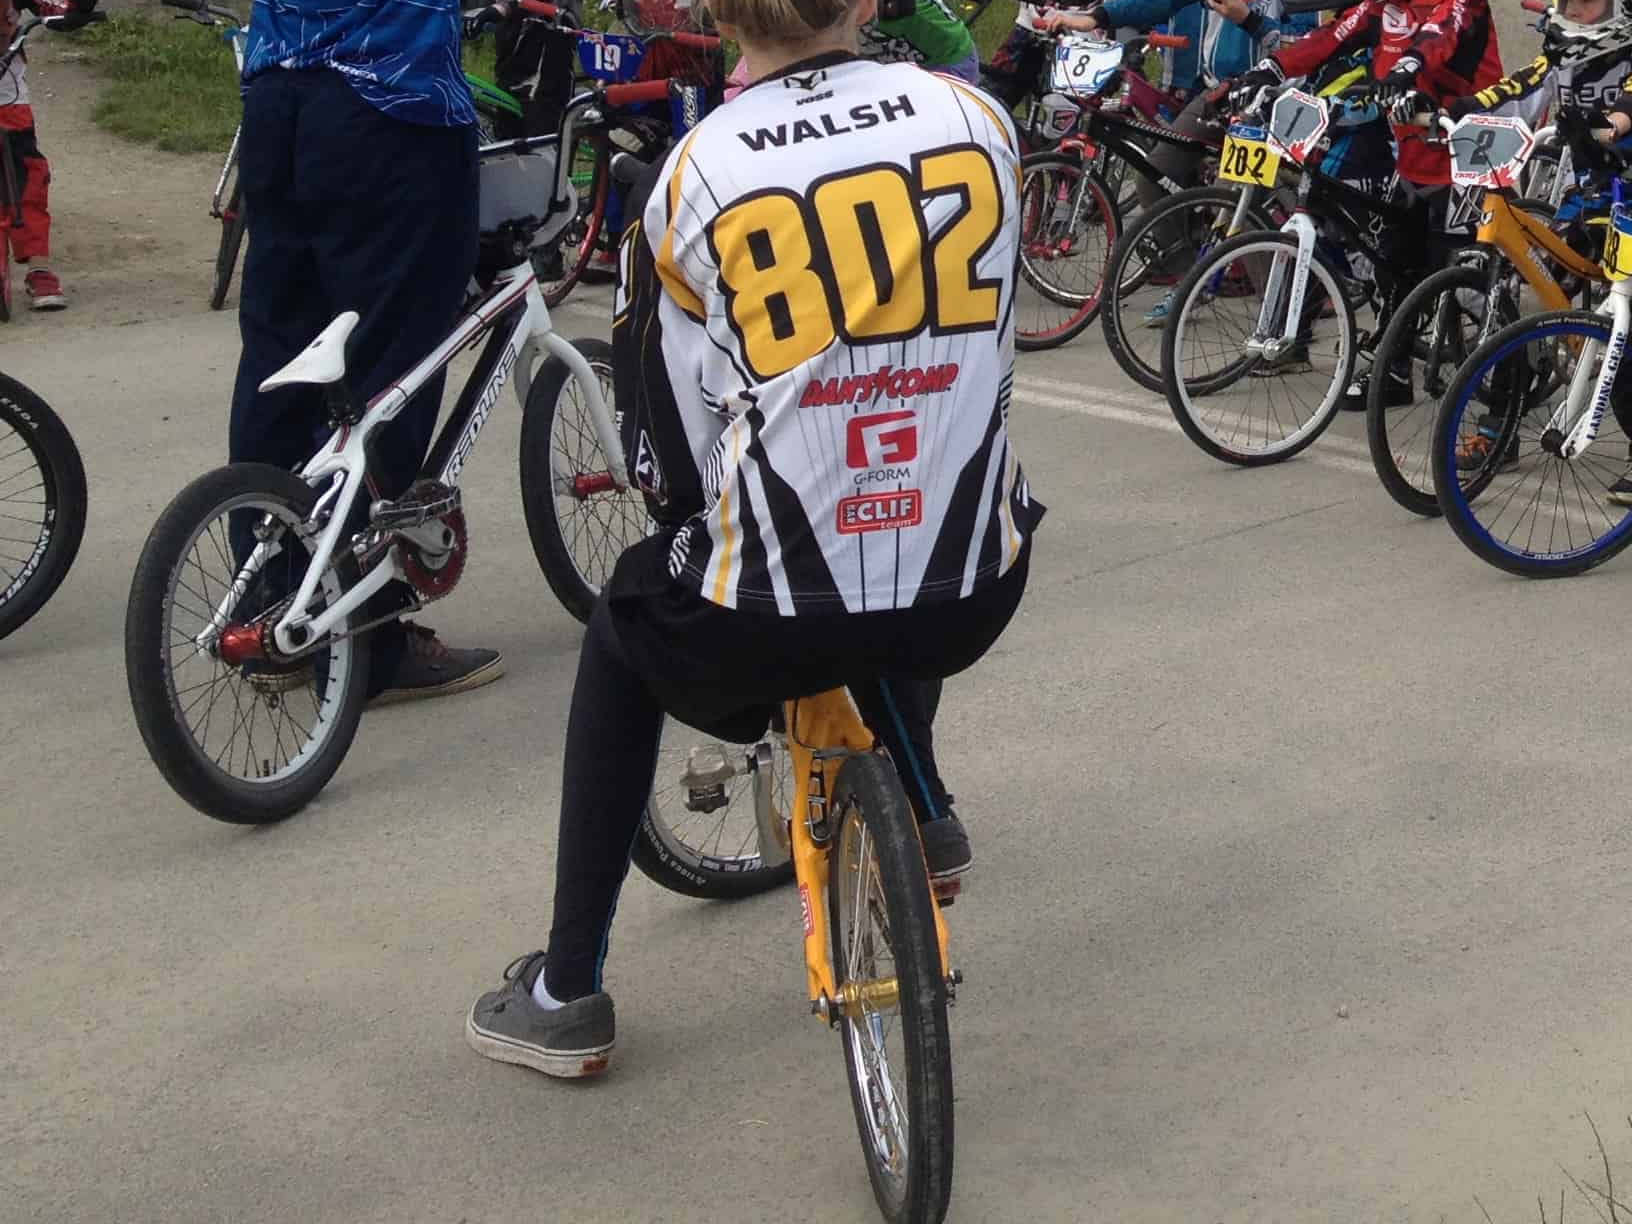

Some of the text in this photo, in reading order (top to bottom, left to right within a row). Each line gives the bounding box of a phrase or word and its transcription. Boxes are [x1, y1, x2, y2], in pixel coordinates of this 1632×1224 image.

[594, 43, 621, 71] 19
[1072, 54, 1091, 77] 8
[737, 94, 916, 152] WALSH
[1223, 142, 1267, 178] 202
[1469, 129, 1497, 166] 2
[708, 142, 1004, 382] 802
[1586, 331, 1629, 441] LANDING GEAR
[0, 397, 39, 430] ENDA
[447, 341, 519, 487] REDLINE
[854, 467, 911, 485] G-FORM
[857, 497, 913, 521] CLIF
